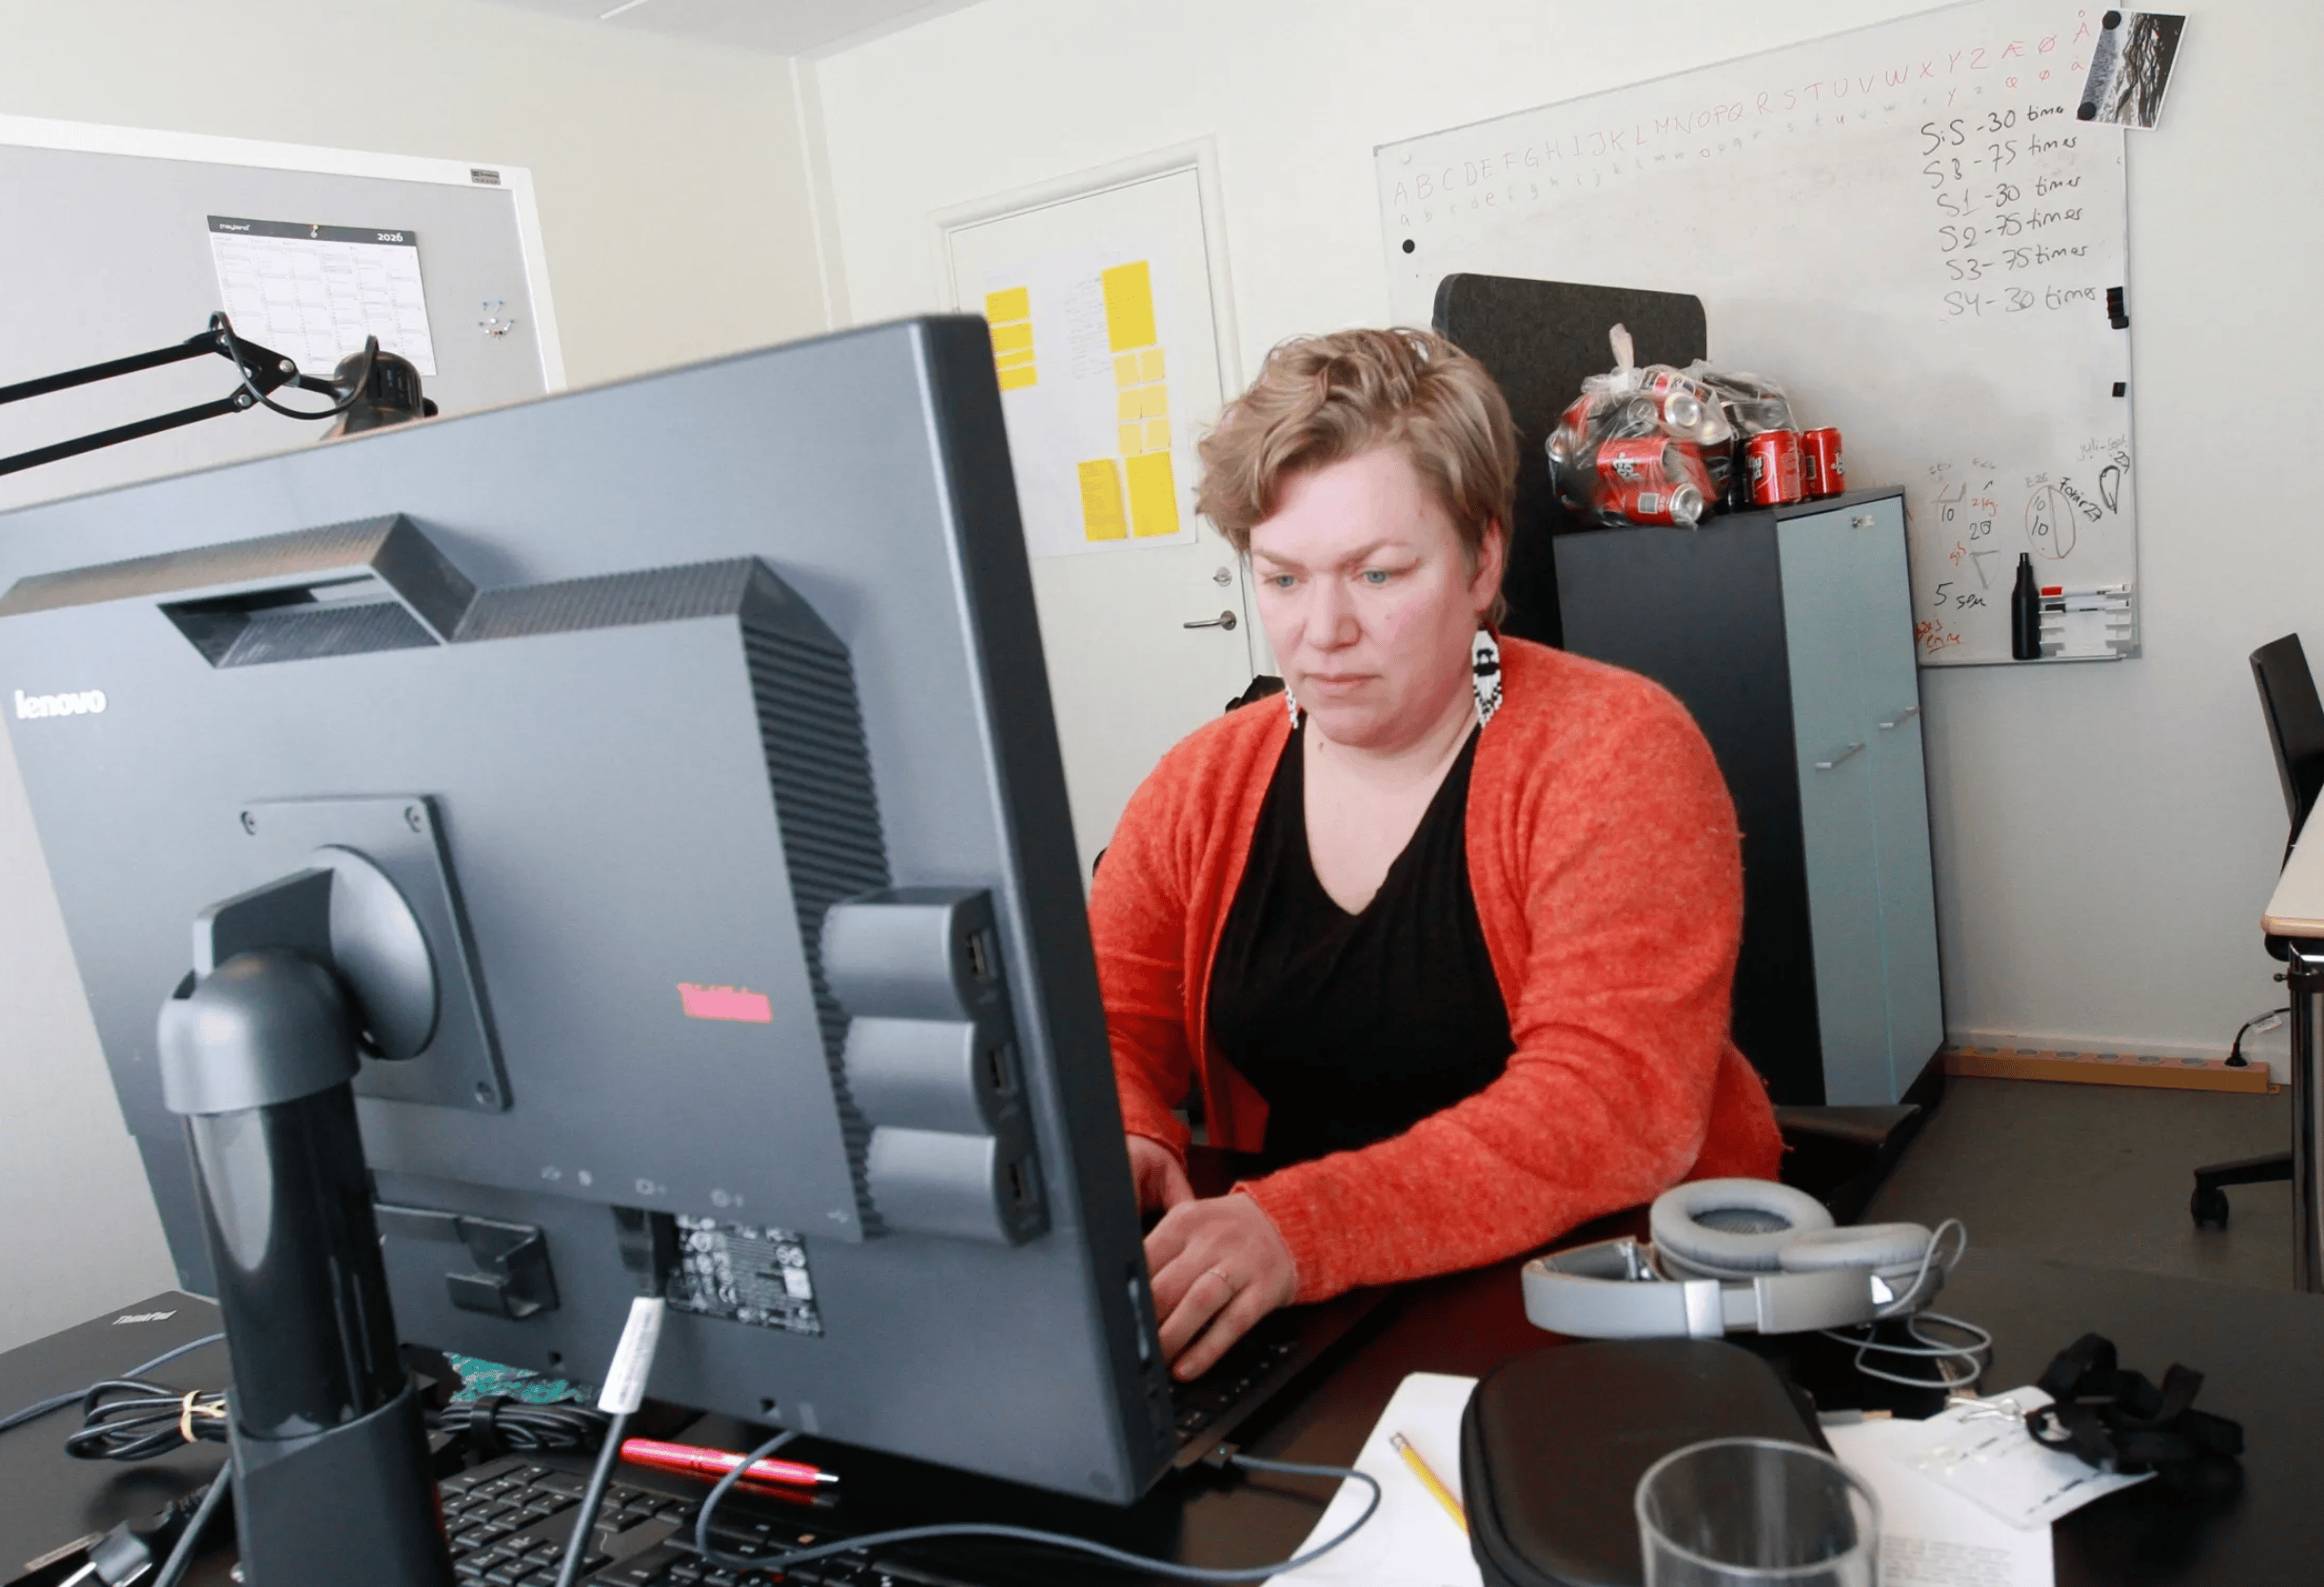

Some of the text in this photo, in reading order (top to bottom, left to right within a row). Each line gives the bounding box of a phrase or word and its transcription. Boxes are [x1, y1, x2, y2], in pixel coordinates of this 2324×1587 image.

[377, 232, 404, 243] 2026
[1941, 504, 1955, 521] 10
[2032, 515, 2048, 536] 10
